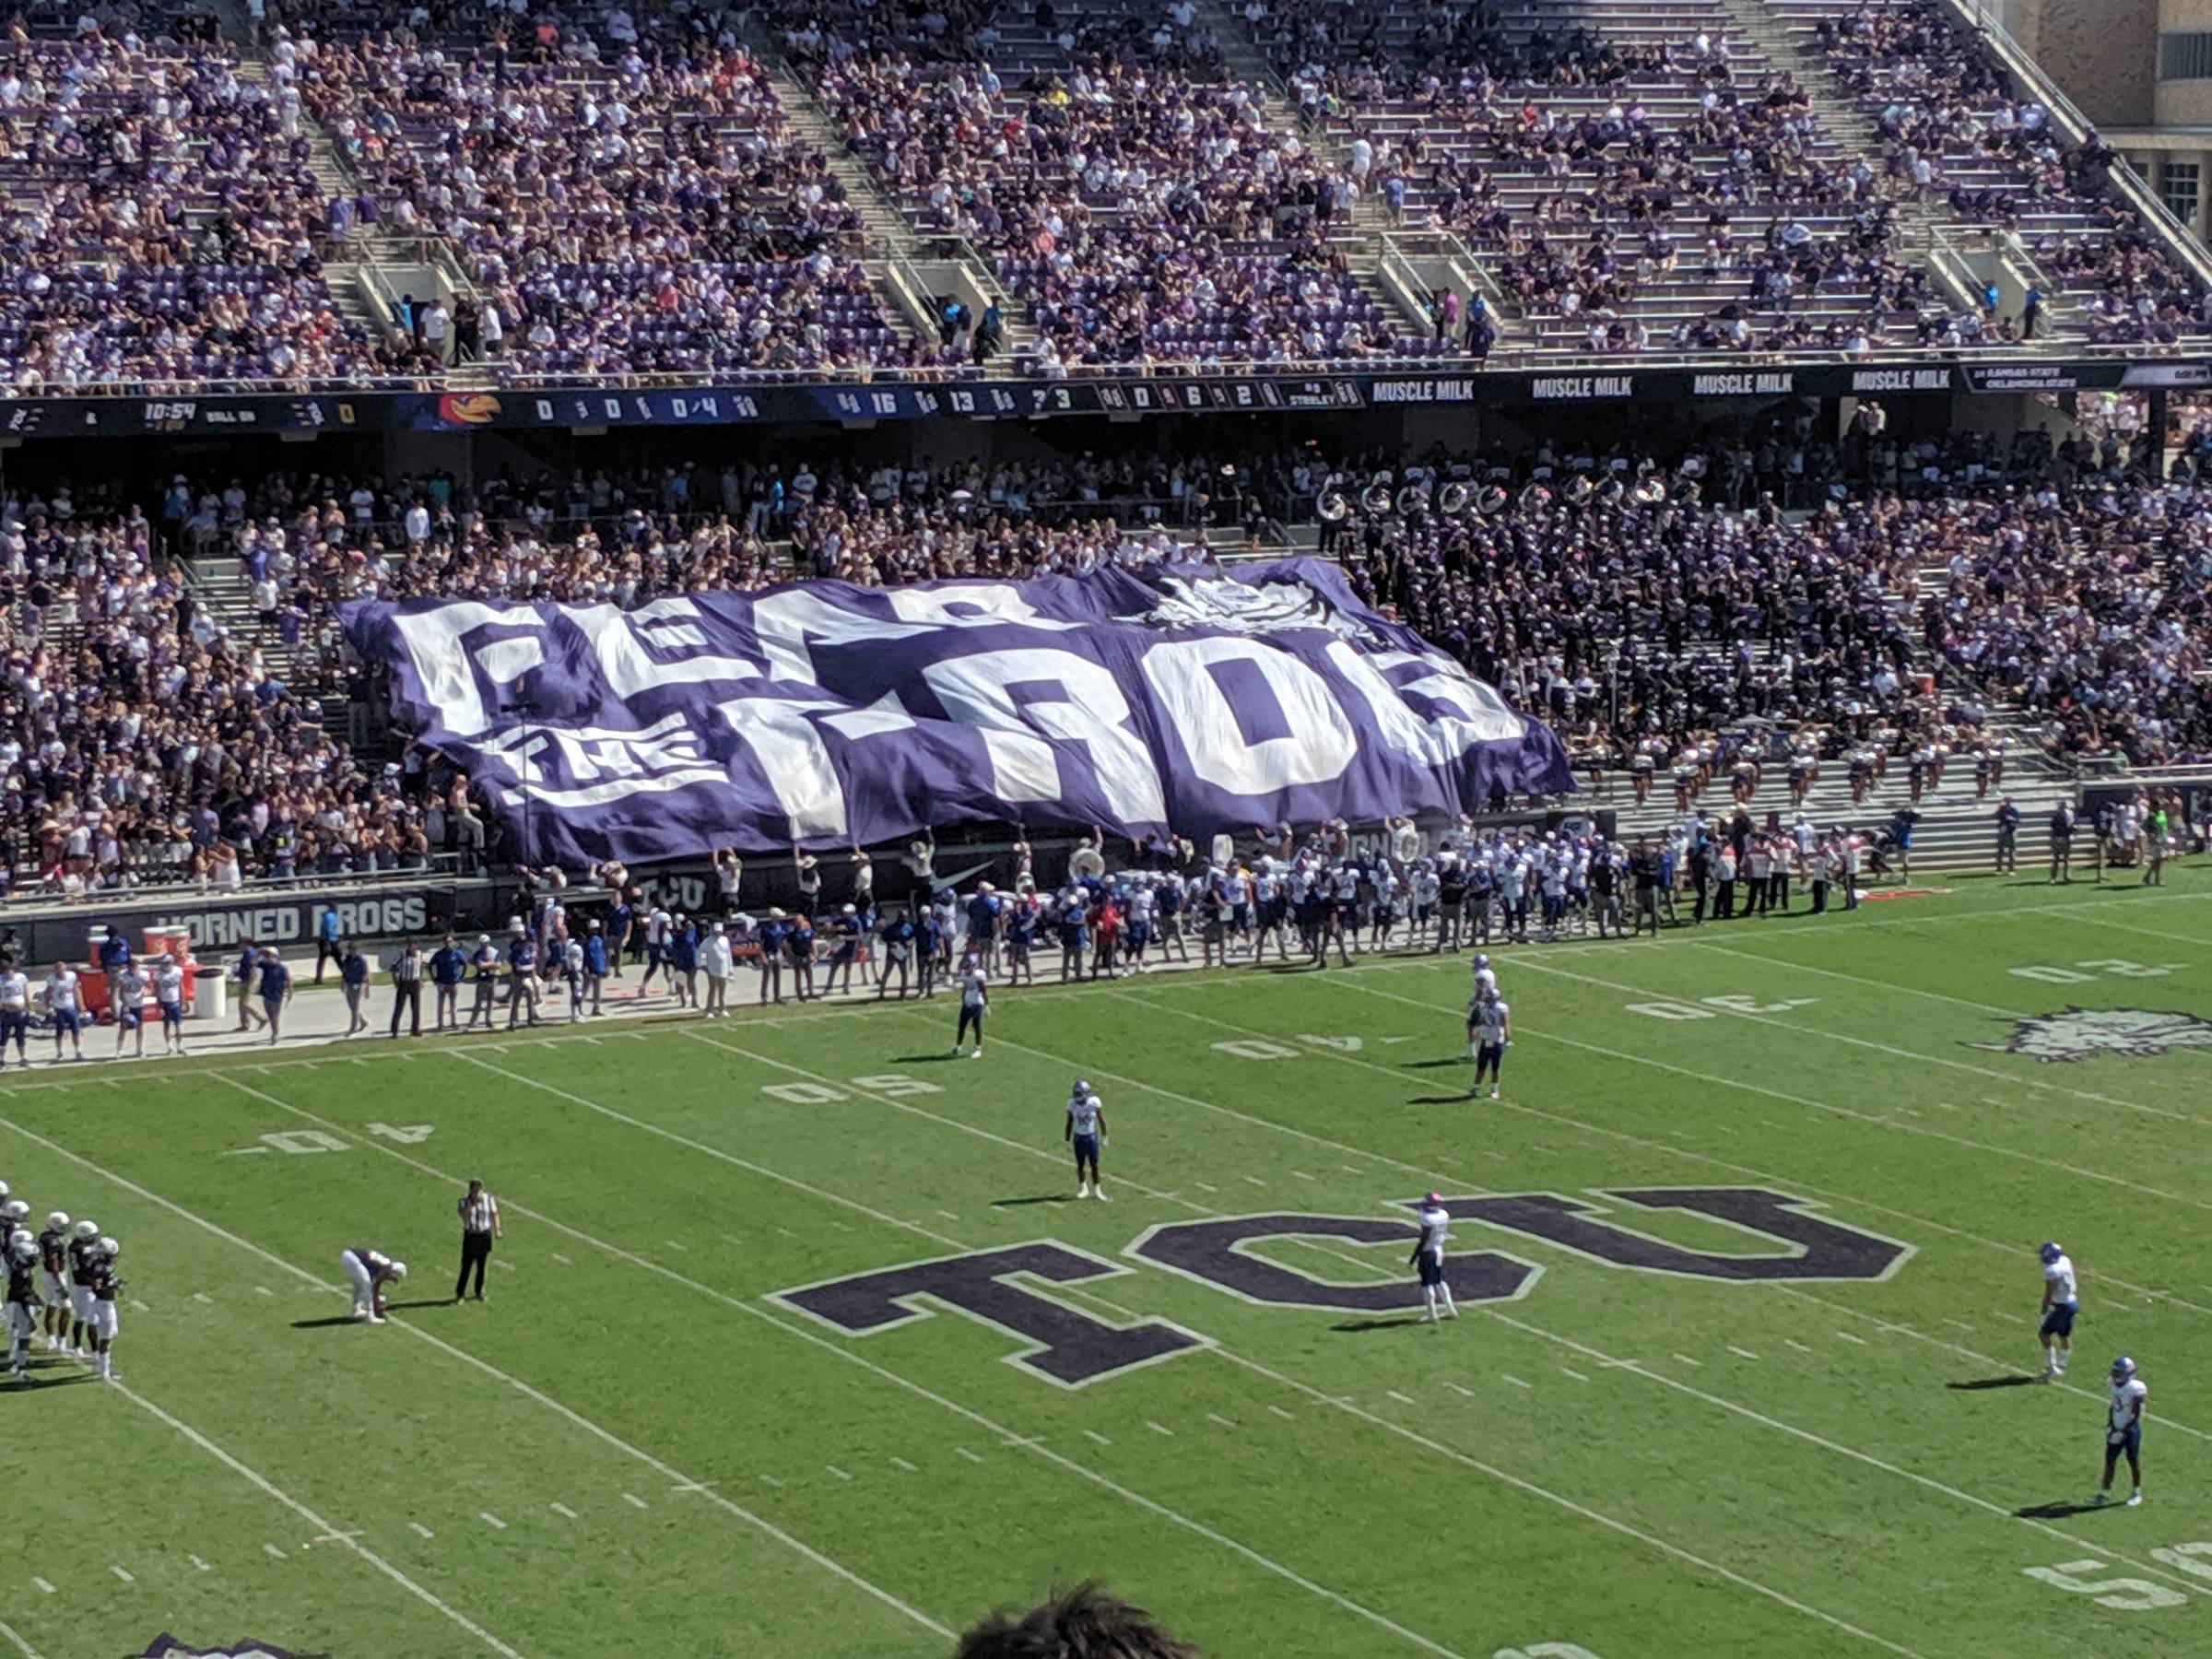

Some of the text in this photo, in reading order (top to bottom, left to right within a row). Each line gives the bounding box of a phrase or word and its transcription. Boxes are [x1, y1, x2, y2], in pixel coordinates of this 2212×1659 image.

[1533, 376, 1633, 398] MUSCLE MILK
[1693, 373, 1794, 394] MUSCLE MILK
[1853, 369, 1951, 391] MUSCLE MILK
[950, 391, 975, 411] 13
[1055, 389, 1071, 408] 3
[1134, 386, 1150, 407] 0
[1187, 386, 1202, 406] 6
[1236, 385, 1252, 405] 2
[1373, 382, 1433, 402] MUSCLE
[1436, 380, 1474, 401] MILK
[145, 403, 196, 420] 10:54
[339, 403, 356, 424] 0
[536, 399, 553, 420] 0
[605, 398, 621, 418] 0
[671, 397, 719, 418] 0/4
[871, 393, 897, 414] 16
[157, 907, 300, 947] ORNED
[763, 1185, 1920, 1389] TCU
